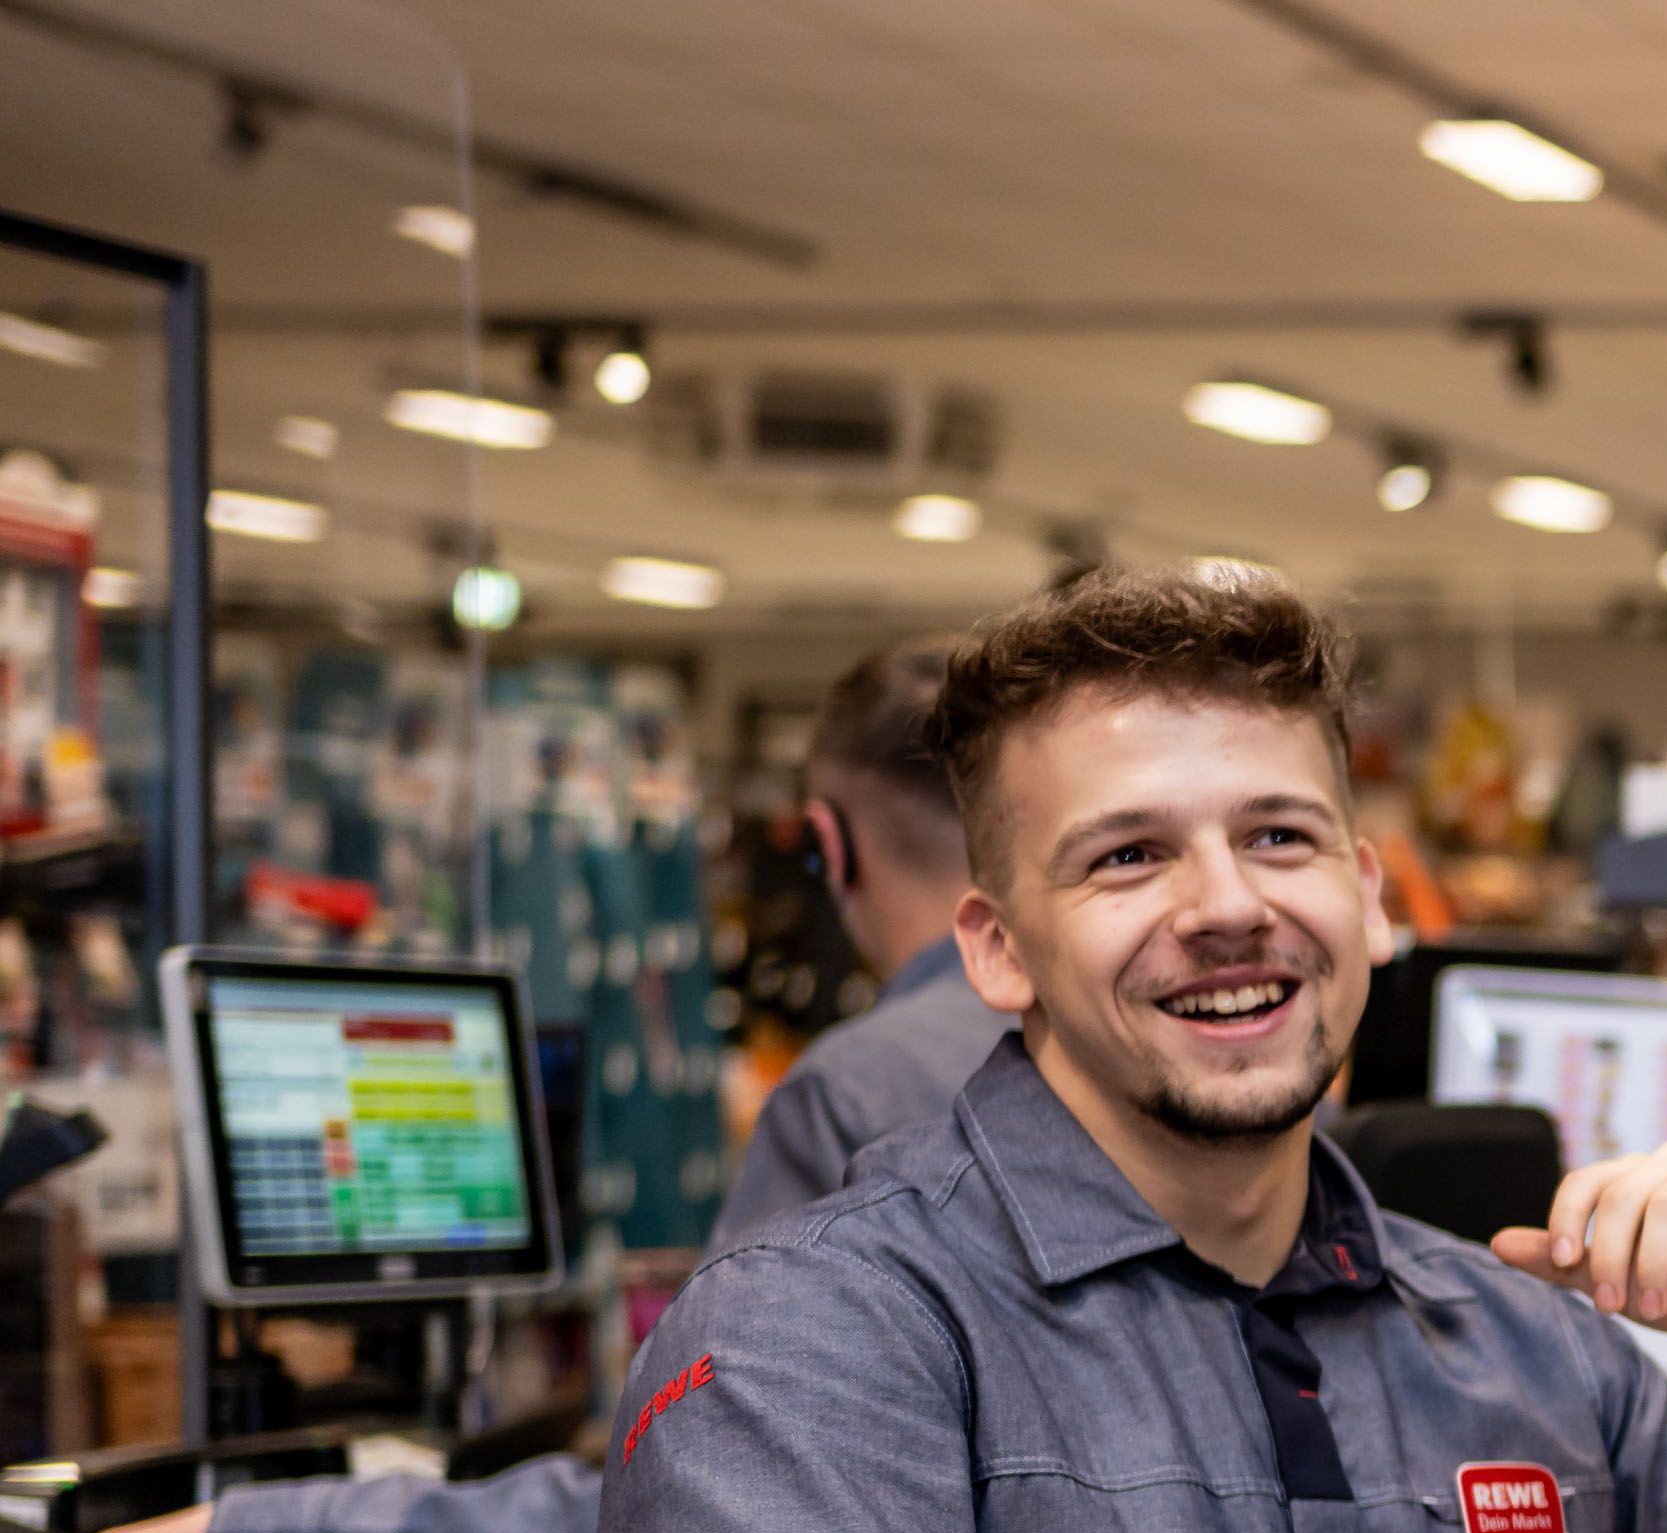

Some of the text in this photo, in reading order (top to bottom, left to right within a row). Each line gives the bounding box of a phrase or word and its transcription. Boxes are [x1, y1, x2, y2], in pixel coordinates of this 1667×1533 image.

[624, 1353, 715, 1466] REWE
[1472, 1481, 1549, 1510] REWE
[1478, 1512, 1552, 1533] Dein Markt
